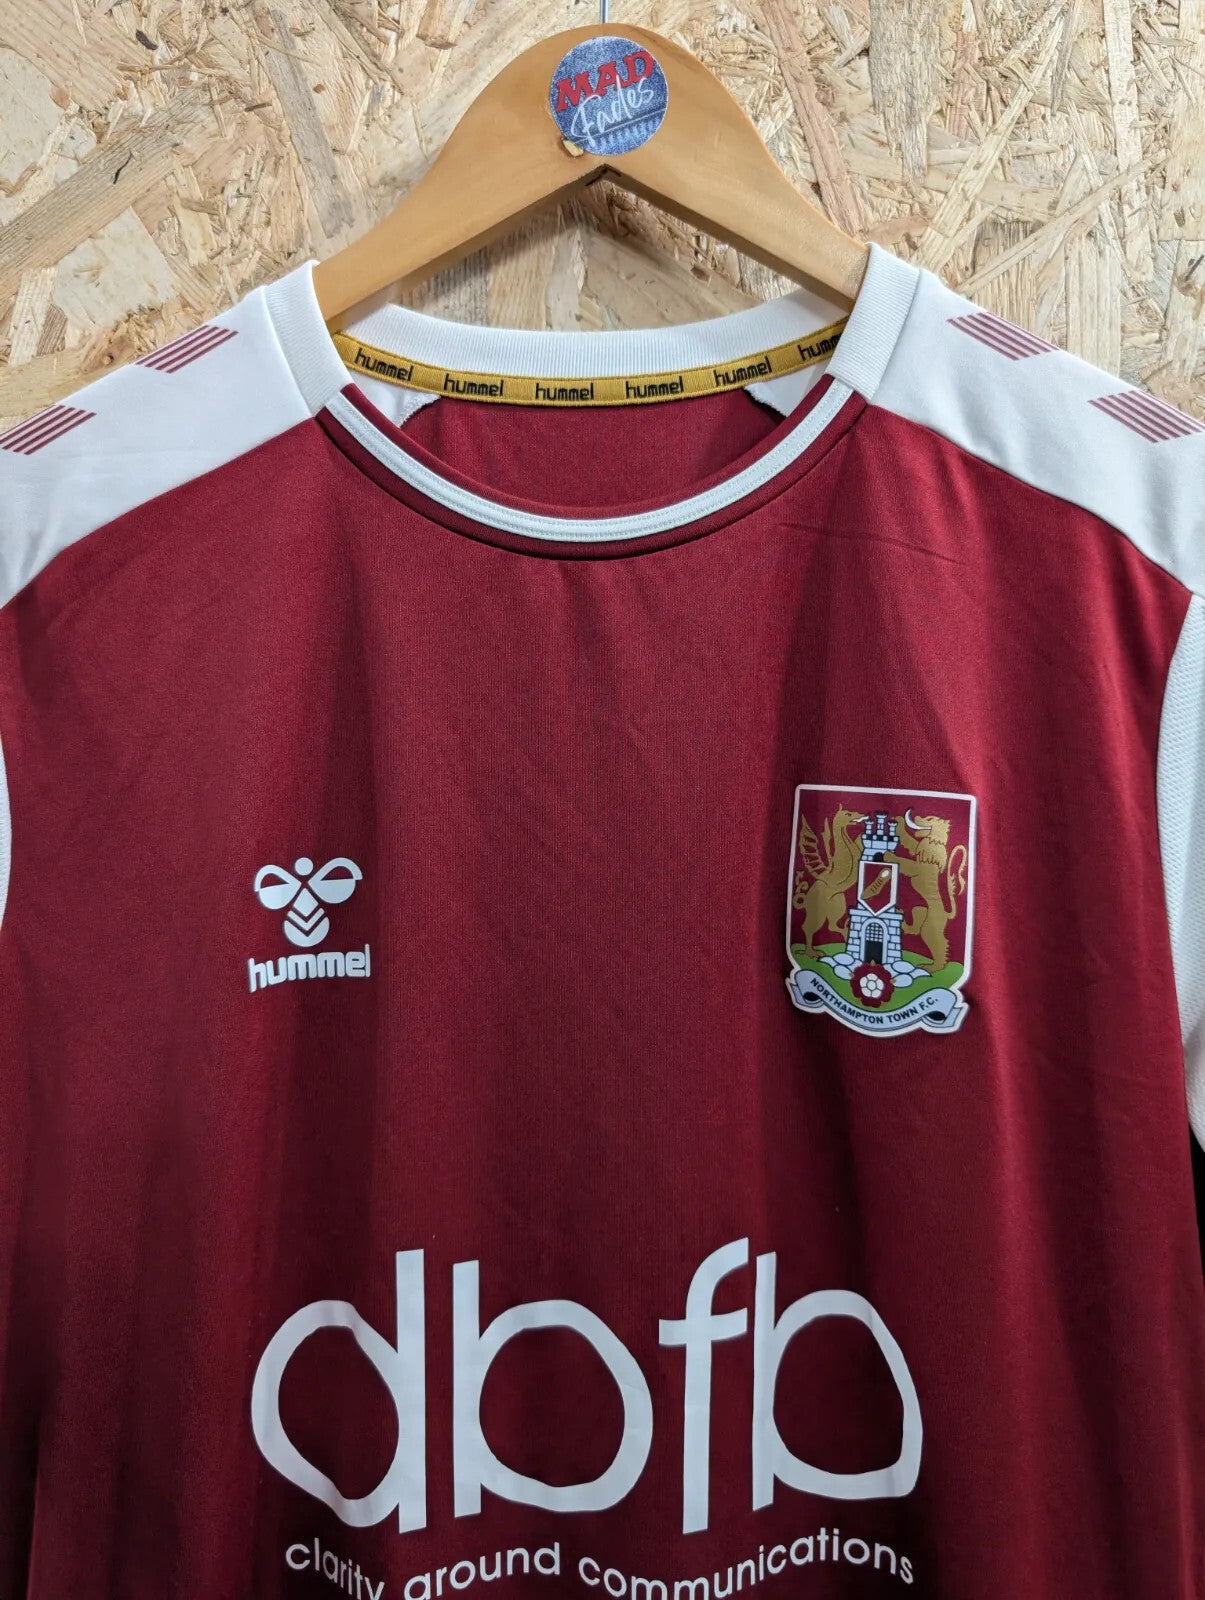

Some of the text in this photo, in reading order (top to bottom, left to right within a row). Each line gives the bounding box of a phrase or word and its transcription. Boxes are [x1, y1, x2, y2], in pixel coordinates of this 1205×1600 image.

[556, 50, 655, 113] MAD
[354, 348, 413, 382] hummel
[443, 373, 504, 397] hummel
[535, 382, 594, 401] hummel
[625, 376, 684, 399] hummel
[713, 356, 772, 387] hummel
[247, 943, 371, 993] hummel
[810, 977, 938, 1024] NORTHAMPTON TOWN F.C.
[251, 1237, 923, 1534] dbfb
[285, 1527, 914, 1600] clarity around communications
